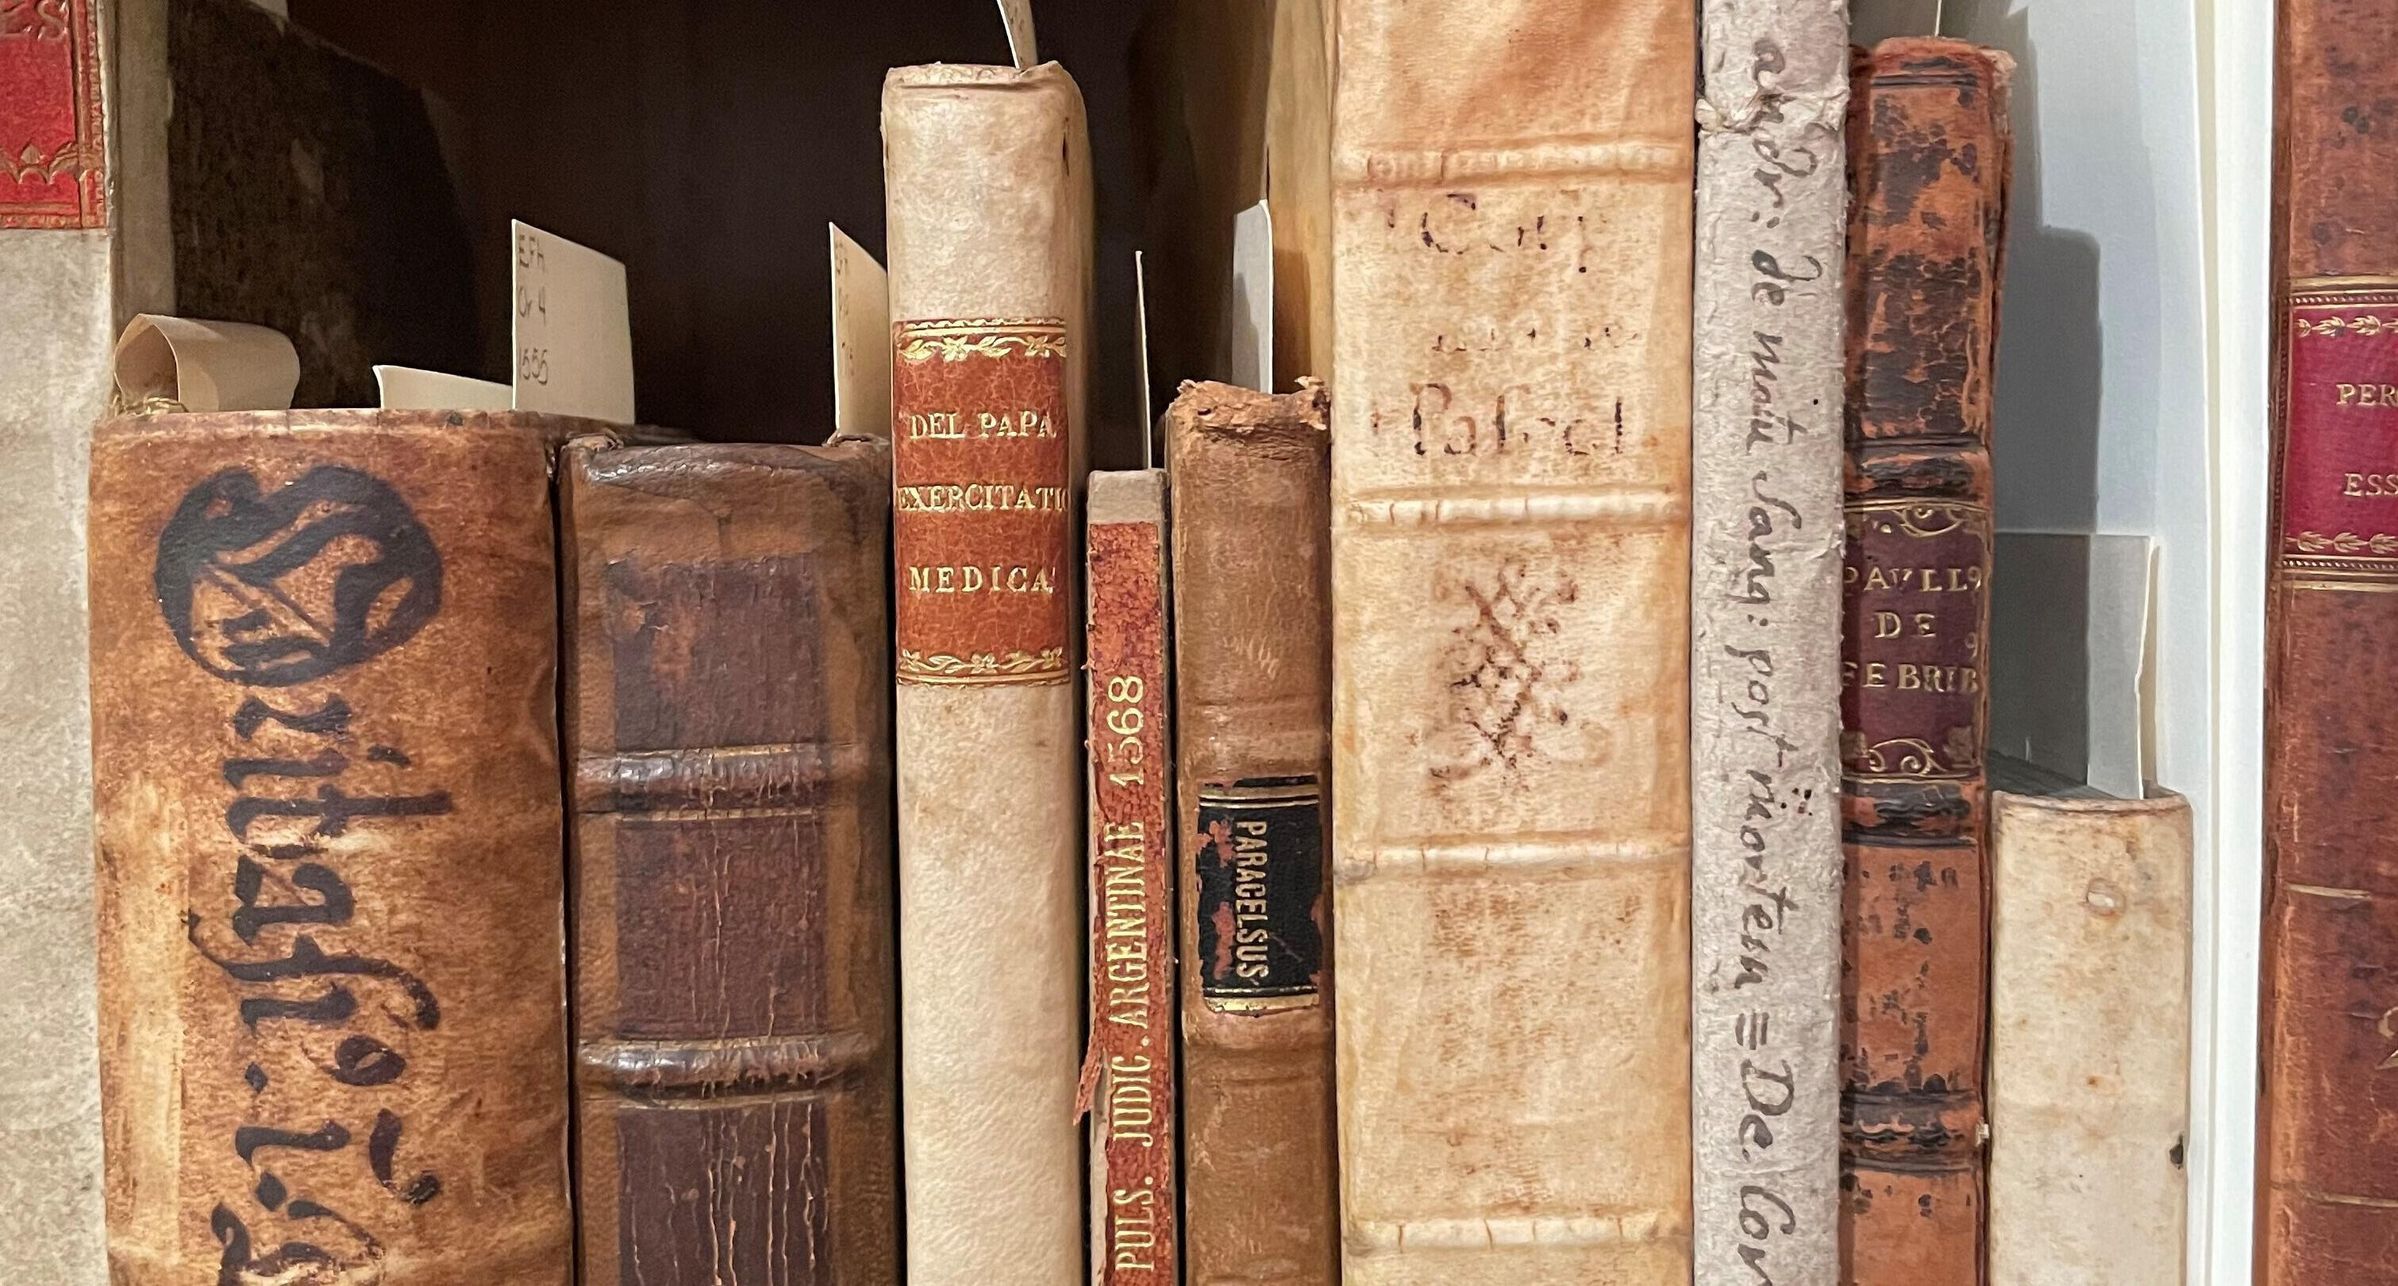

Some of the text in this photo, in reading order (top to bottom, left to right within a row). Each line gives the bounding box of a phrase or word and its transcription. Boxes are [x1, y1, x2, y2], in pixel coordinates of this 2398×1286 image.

[909, 410, 1057, 440] DEL PAPA
[2336, 383, 2398, 407] PER
[1872, 611, 1937, 640] DE
[1725, 644, 1799, 768] post
[1234, 820, 1270, 979] PARACELSUS
[1104, 675, 1156, 1273] PULS. JUDIC. ARGENTINAE 1568
